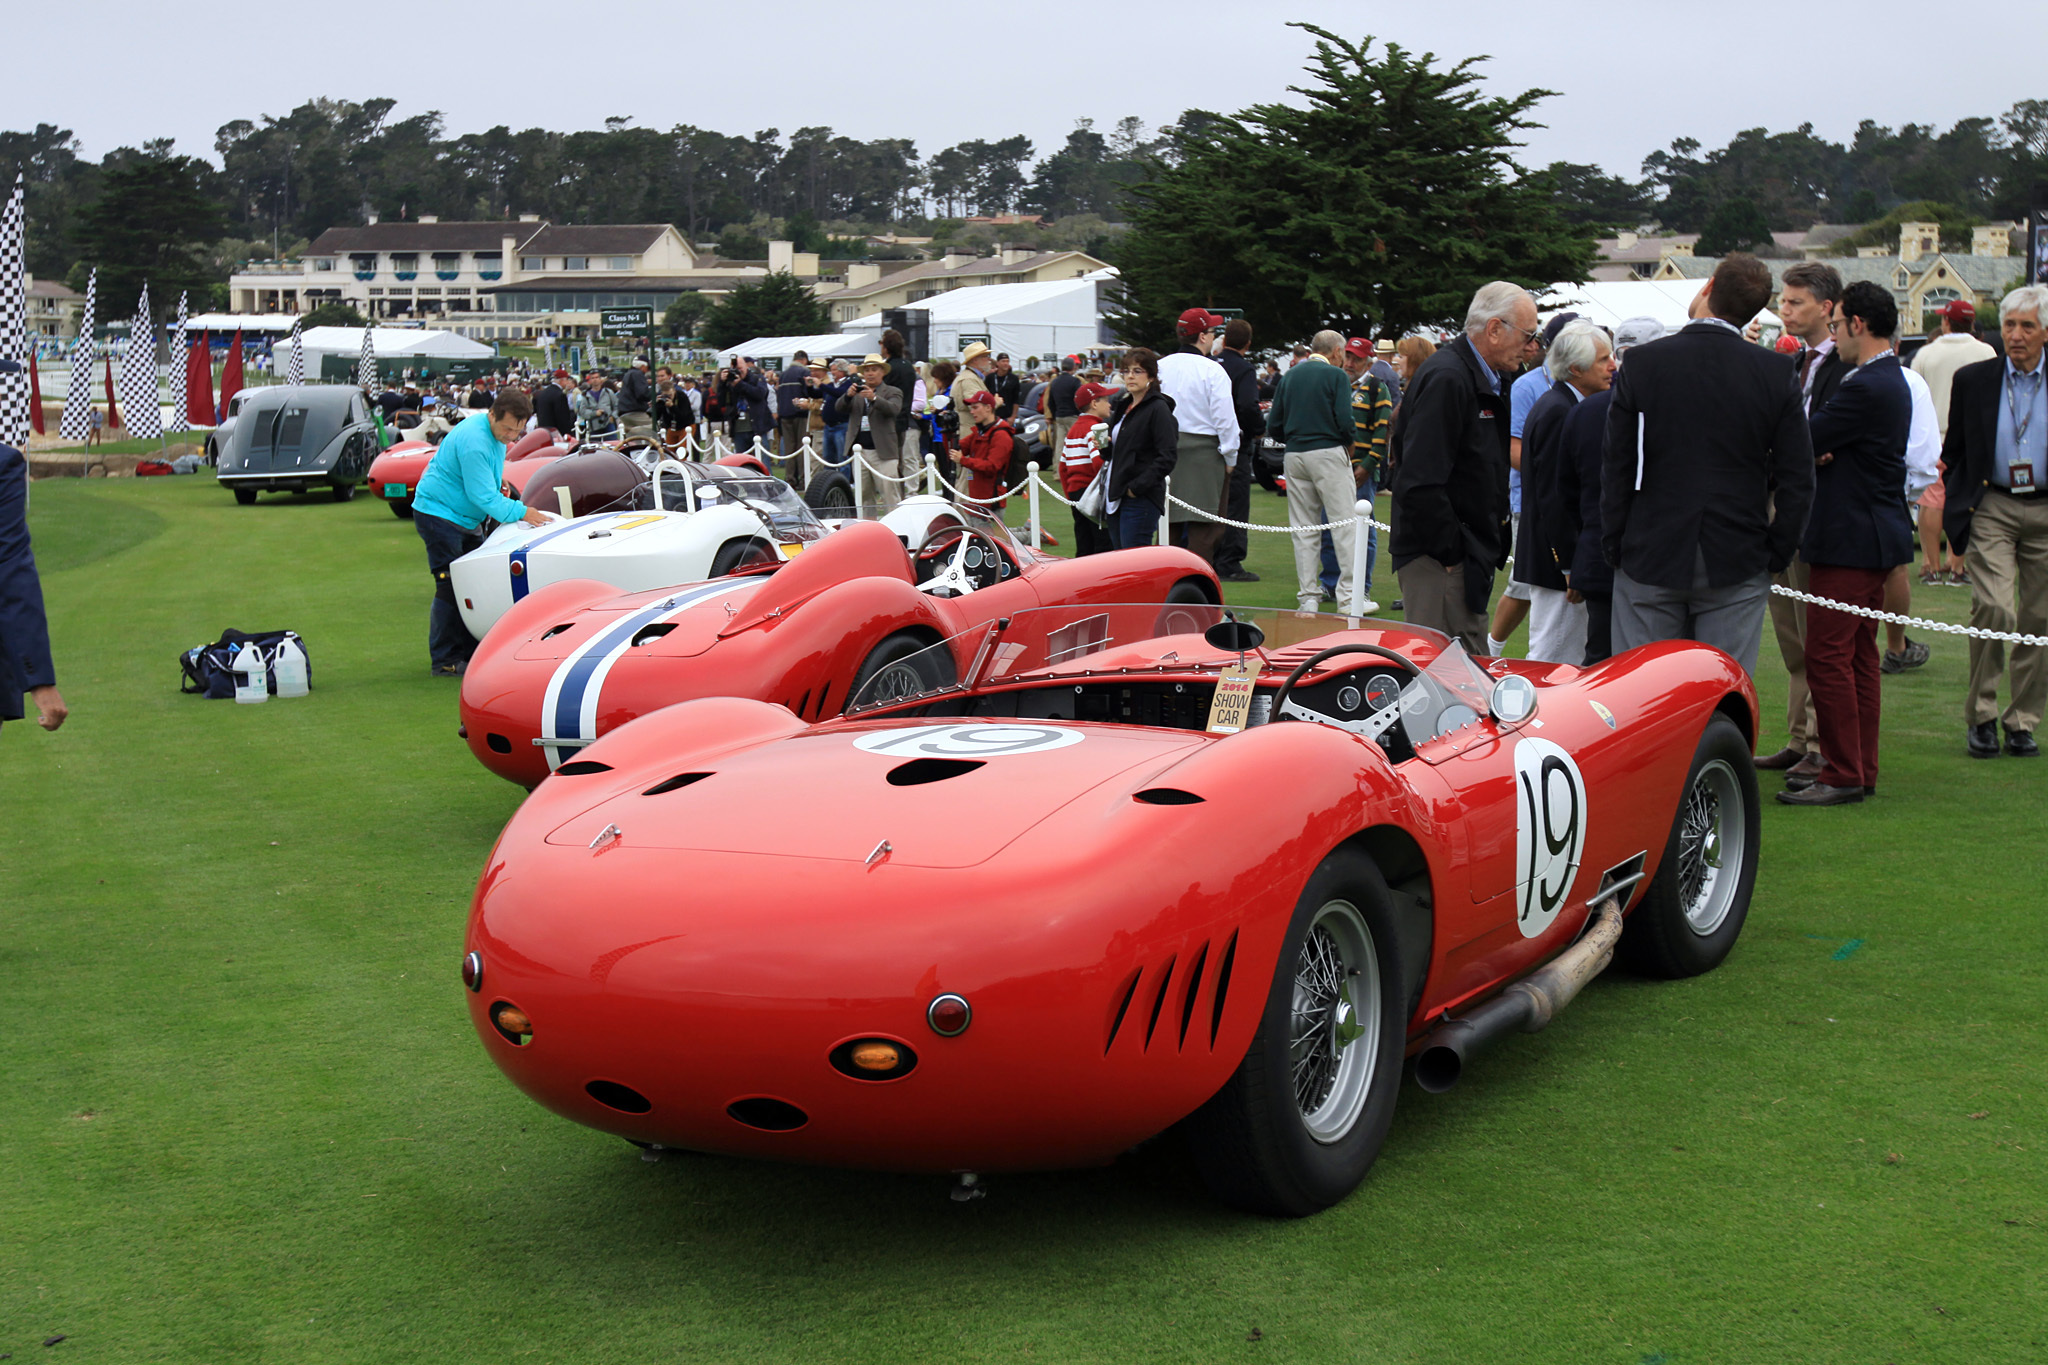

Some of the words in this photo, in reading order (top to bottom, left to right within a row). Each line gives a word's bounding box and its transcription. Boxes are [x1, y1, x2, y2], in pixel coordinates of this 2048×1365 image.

[611, 514, 668, 530] 7
[1221, 683, 1249, 692] 2014
[1214, 693, 1250, 709] SHOW
[1216, 709, 1240, 725] CAR
[867, 725, 1064, 755] 19
[1519, 754, 1579, 922] 19
